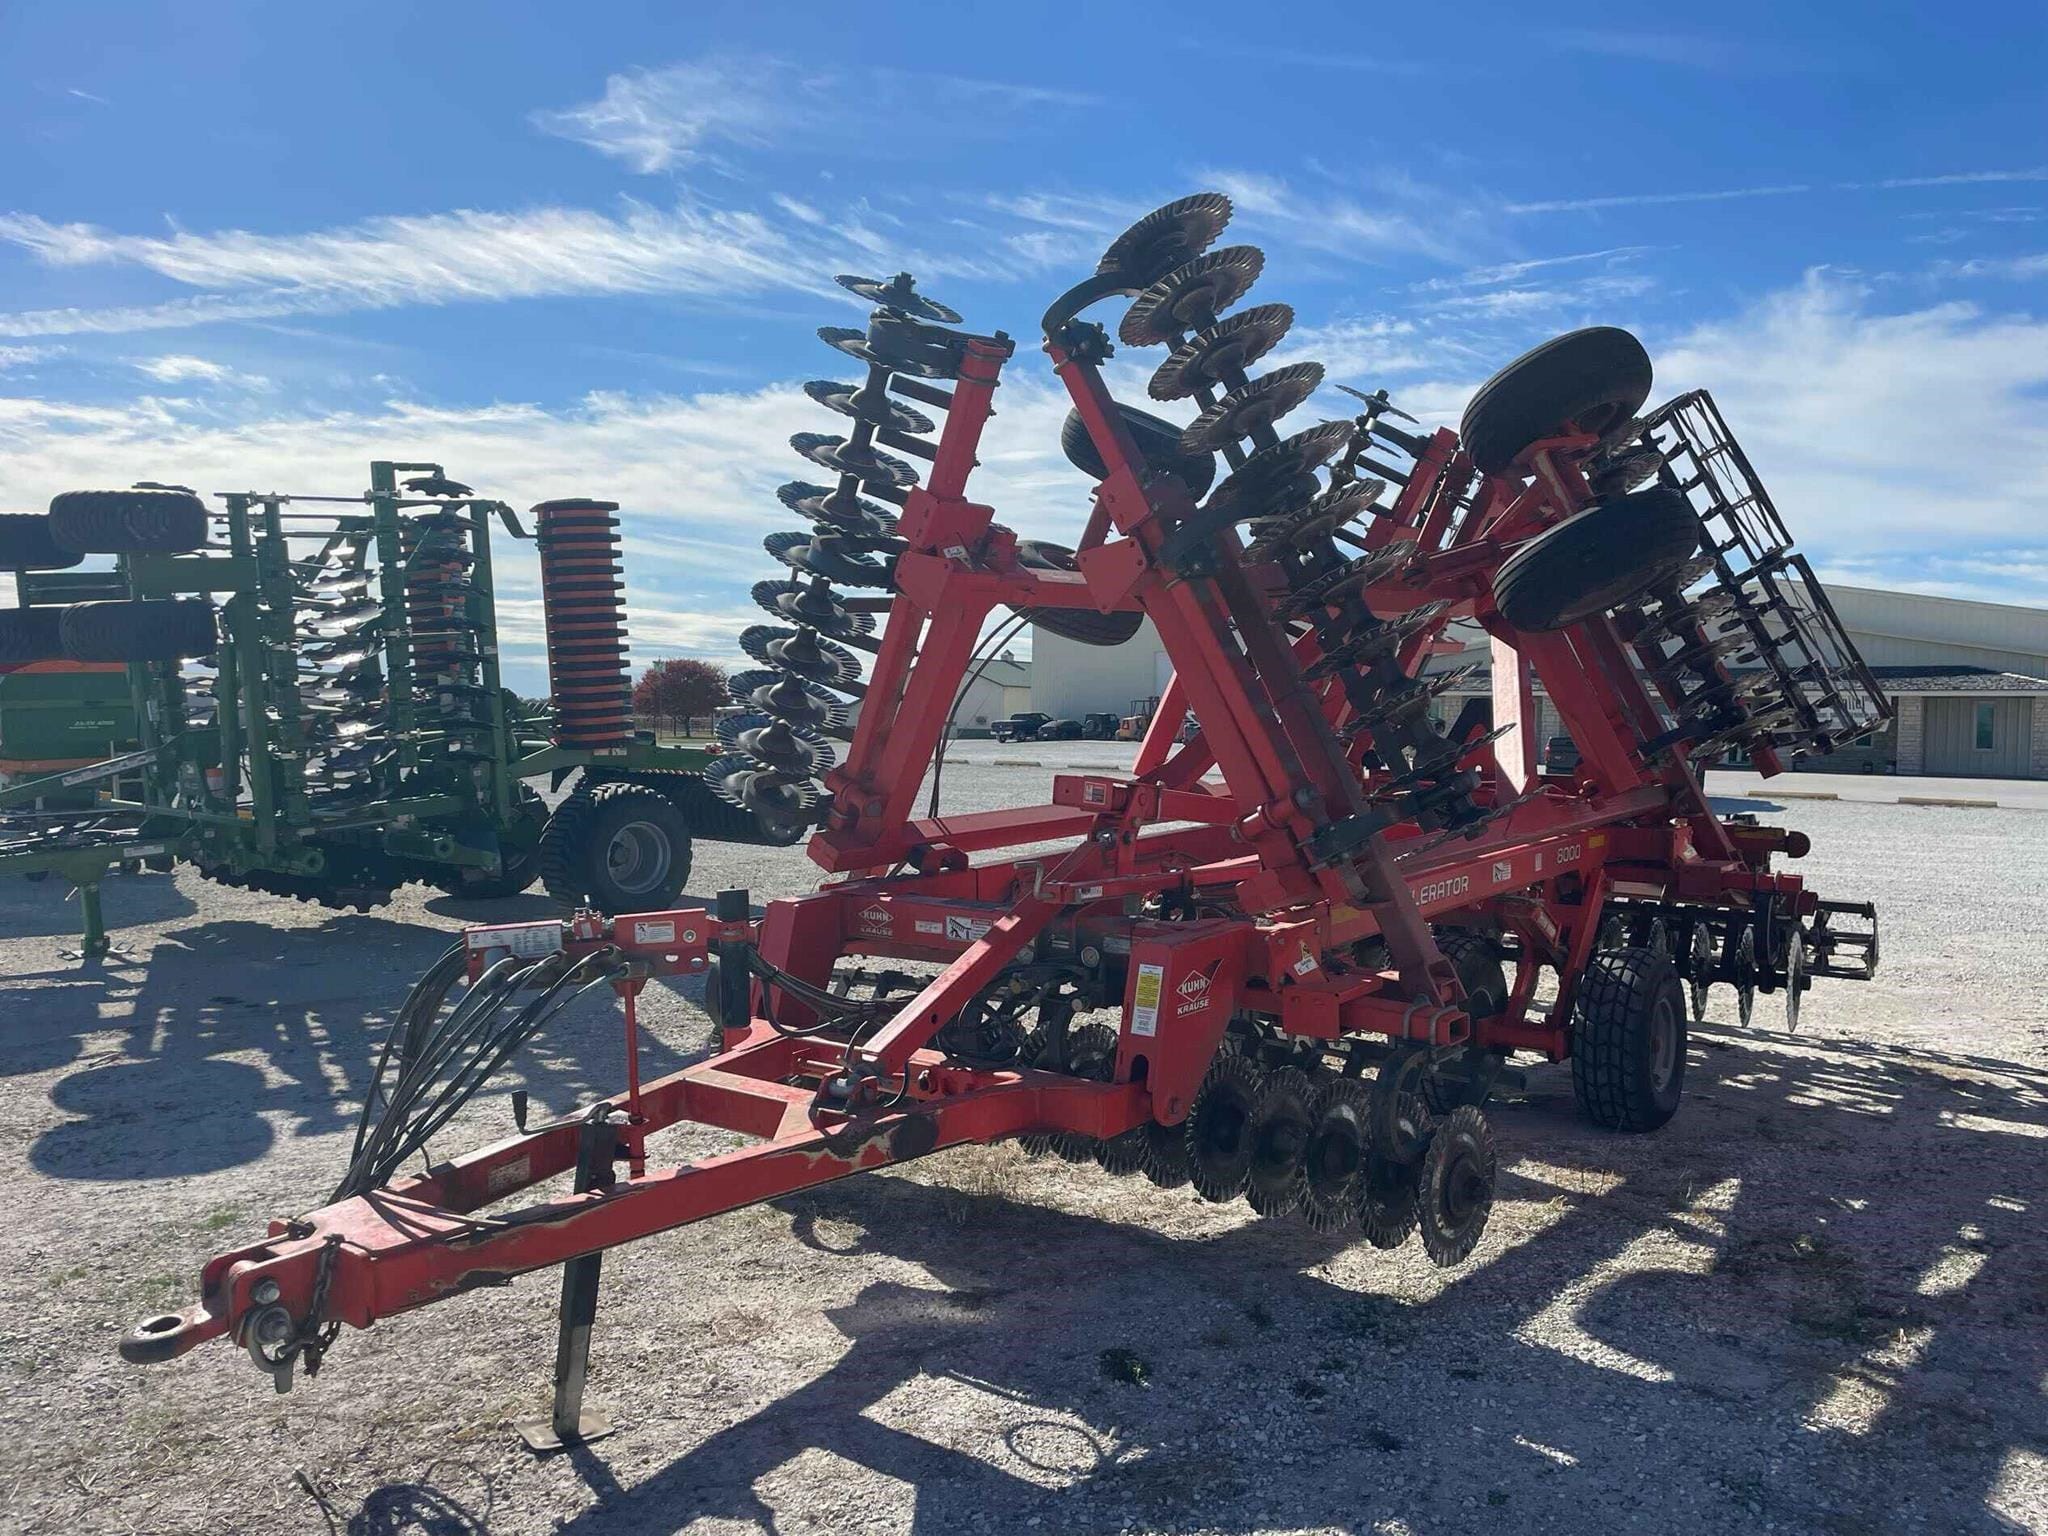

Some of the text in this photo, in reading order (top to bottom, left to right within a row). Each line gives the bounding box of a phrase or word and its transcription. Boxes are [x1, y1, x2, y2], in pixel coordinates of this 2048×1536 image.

[1556, 845, 1581, 864] 8000
[863, 910, 889, 921] KUHN
[1181, 977, 1206, 994] KUHN
[1177, 998, 1209, 1016] KRAUSE
